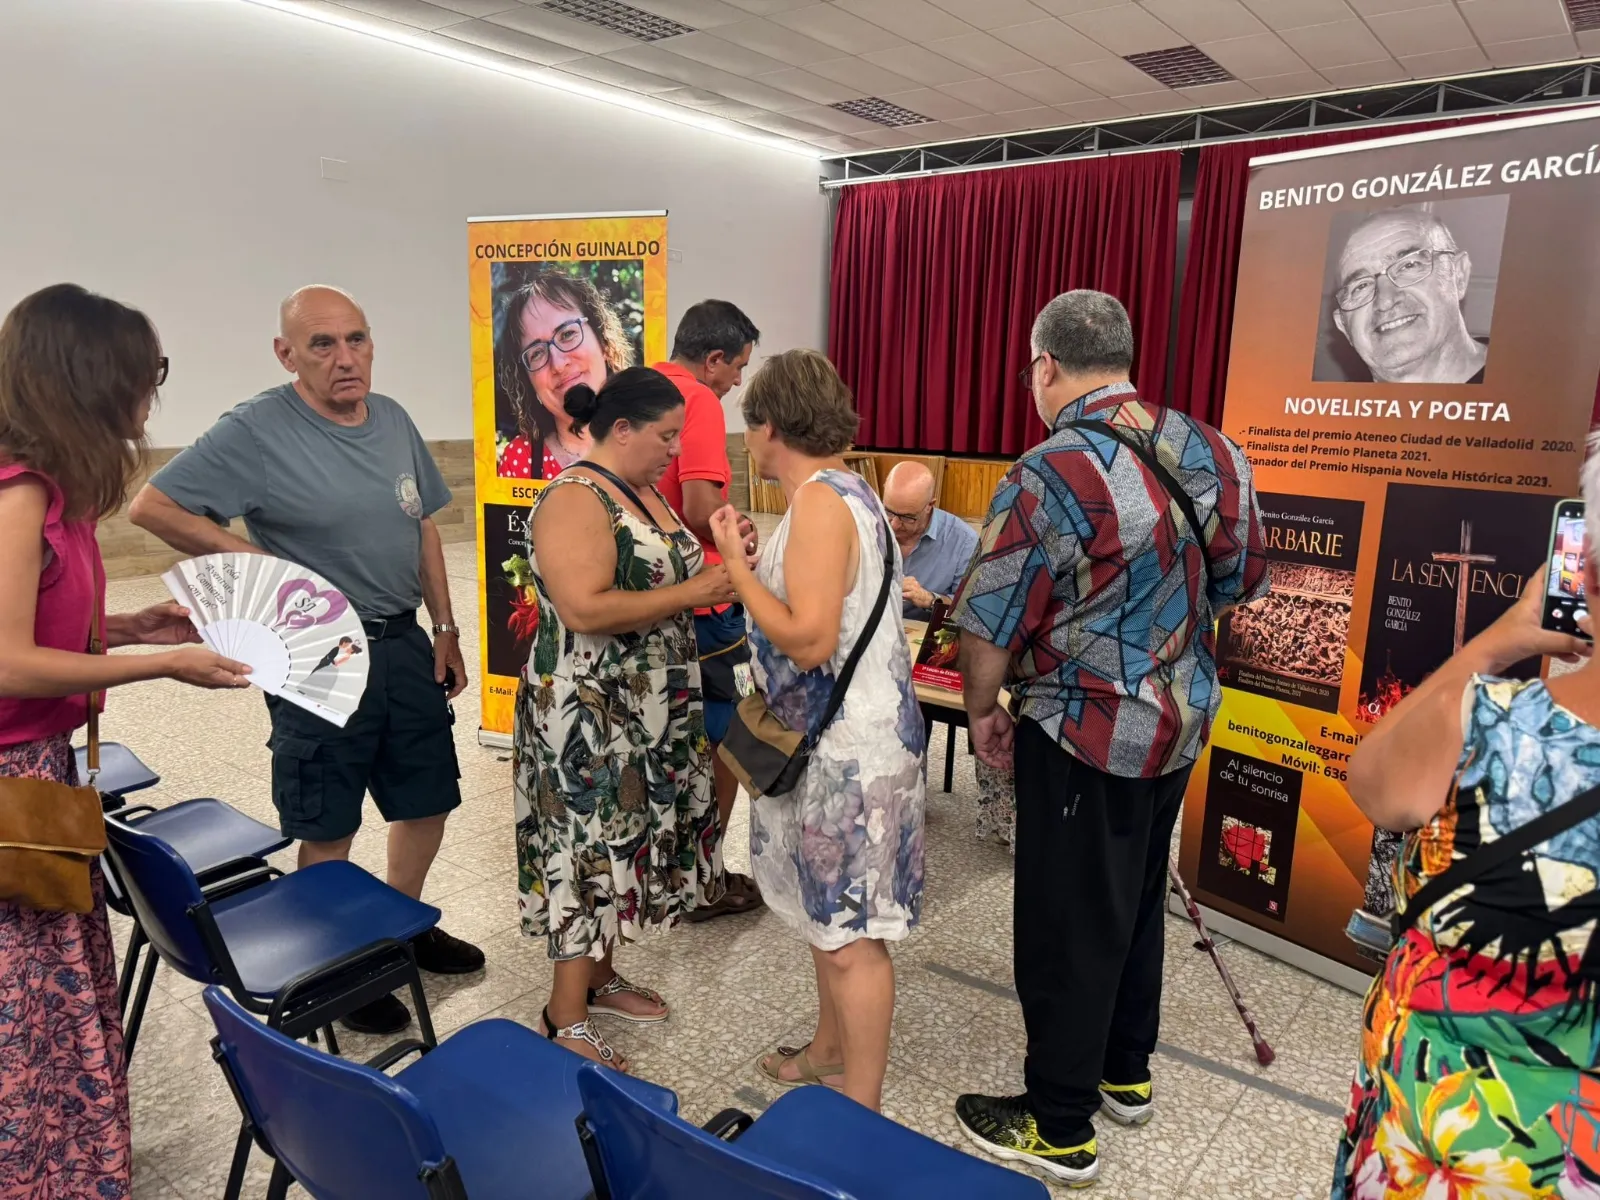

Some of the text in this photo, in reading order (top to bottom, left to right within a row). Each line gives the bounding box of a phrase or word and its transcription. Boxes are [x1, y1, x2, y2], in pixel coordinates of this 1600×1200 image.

[1259, 182, 1344, 210] BENITO
[1351, 163, 1493, 200] GONZÁLEZ
[475, 239, 660, 259] CONCEPCIÓN GUINALDO
[1284, 397, 1511, 422] NOVELISTA Y POETA
[1246, 441, 1289, 453] Finalista
[1292, 442, 1308, 454] del
[1311, 444, 1350, 456] Premio
[1353, 447, 1397, 460] Planeta
[1400, 450, 1431, 462] 2021.
[1248, 426, 1291, 438] Finalista
[1294, 427, 1310, 438] del
[1312, 429, 1352, 441] premio
[1354, 431, 1397, 443] Ateneo
[1400, 433, 1442, 446] Ciudad
[1445, 435, 1462, 447] de
[1465, 436, 1534, 450] Valladolid
[1541, 440, 1577, 453] 2020.
[1291, 458, 1307, 469] del
[1309, 460, 1348, 472] Premio
[1351, 462, 1402, 477] Hispania
[1405, 467, 1448, 480] Novela
[1452, 470, 1512, 485] Histórica
[512, 487, 542, 499] ESCR
[507, 510, 529, 533] Éx
[1260, 509, 1334, 526] Benito González García
[1391, 558, 1414, 584] LA
[1388, 595, 1412, 608] BENITO
[1385, 617, 1408, 632] GARCÍA
[1386, 606, 1421, 622] GONZÁLEZ
[1228, 719, 1351, 763] benitogonzalezgarc
[1320, 726, 1363, 746] E-mail
[1227, 758, 1283, 785] Al silencio
[1281, 753, 1348, 782] Móvil: 636
[1219, 769, 1289, 803] de tu sonrisa
